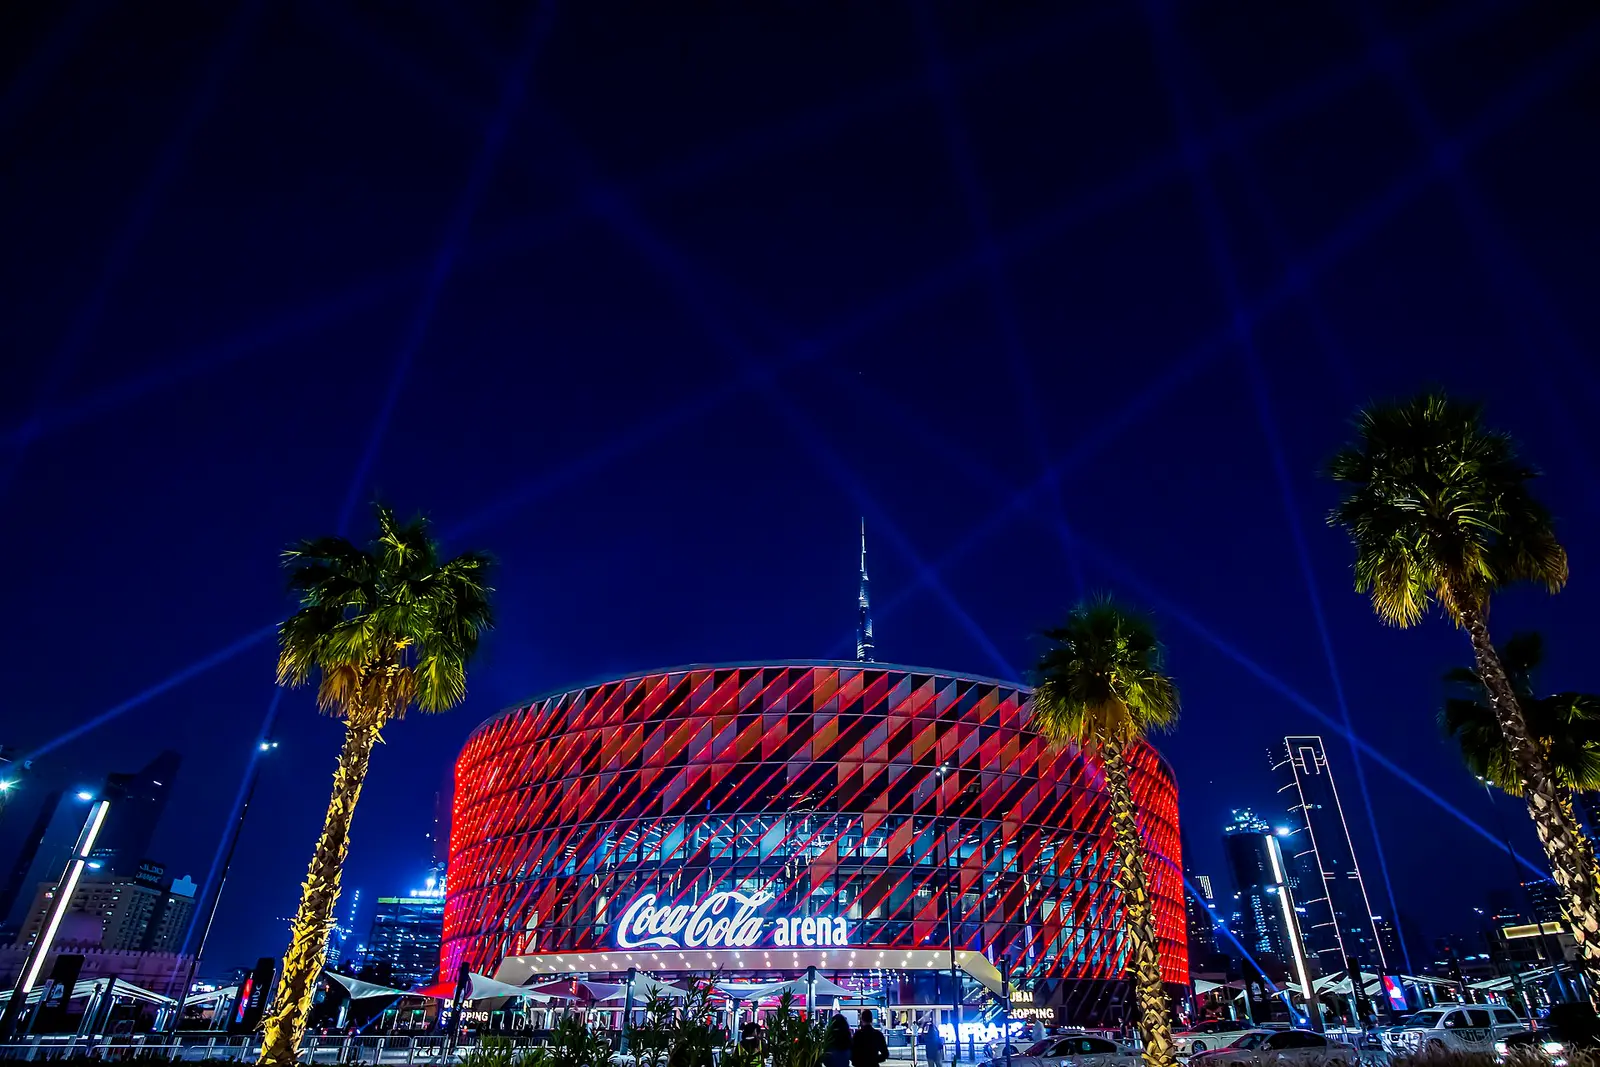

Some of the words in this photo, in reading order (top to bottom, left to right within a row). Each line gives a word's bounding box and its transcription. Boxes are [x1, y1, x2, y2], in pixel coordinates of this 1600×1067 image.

[617, 891, 775, 948] Coca-Cola
[774, 916, 849, 947] arena
[1009, 991, 1034, 1002] UBAI
[443, 998, 473, 1009] DAI
[441, 1010, 489, 1022] SPPING
